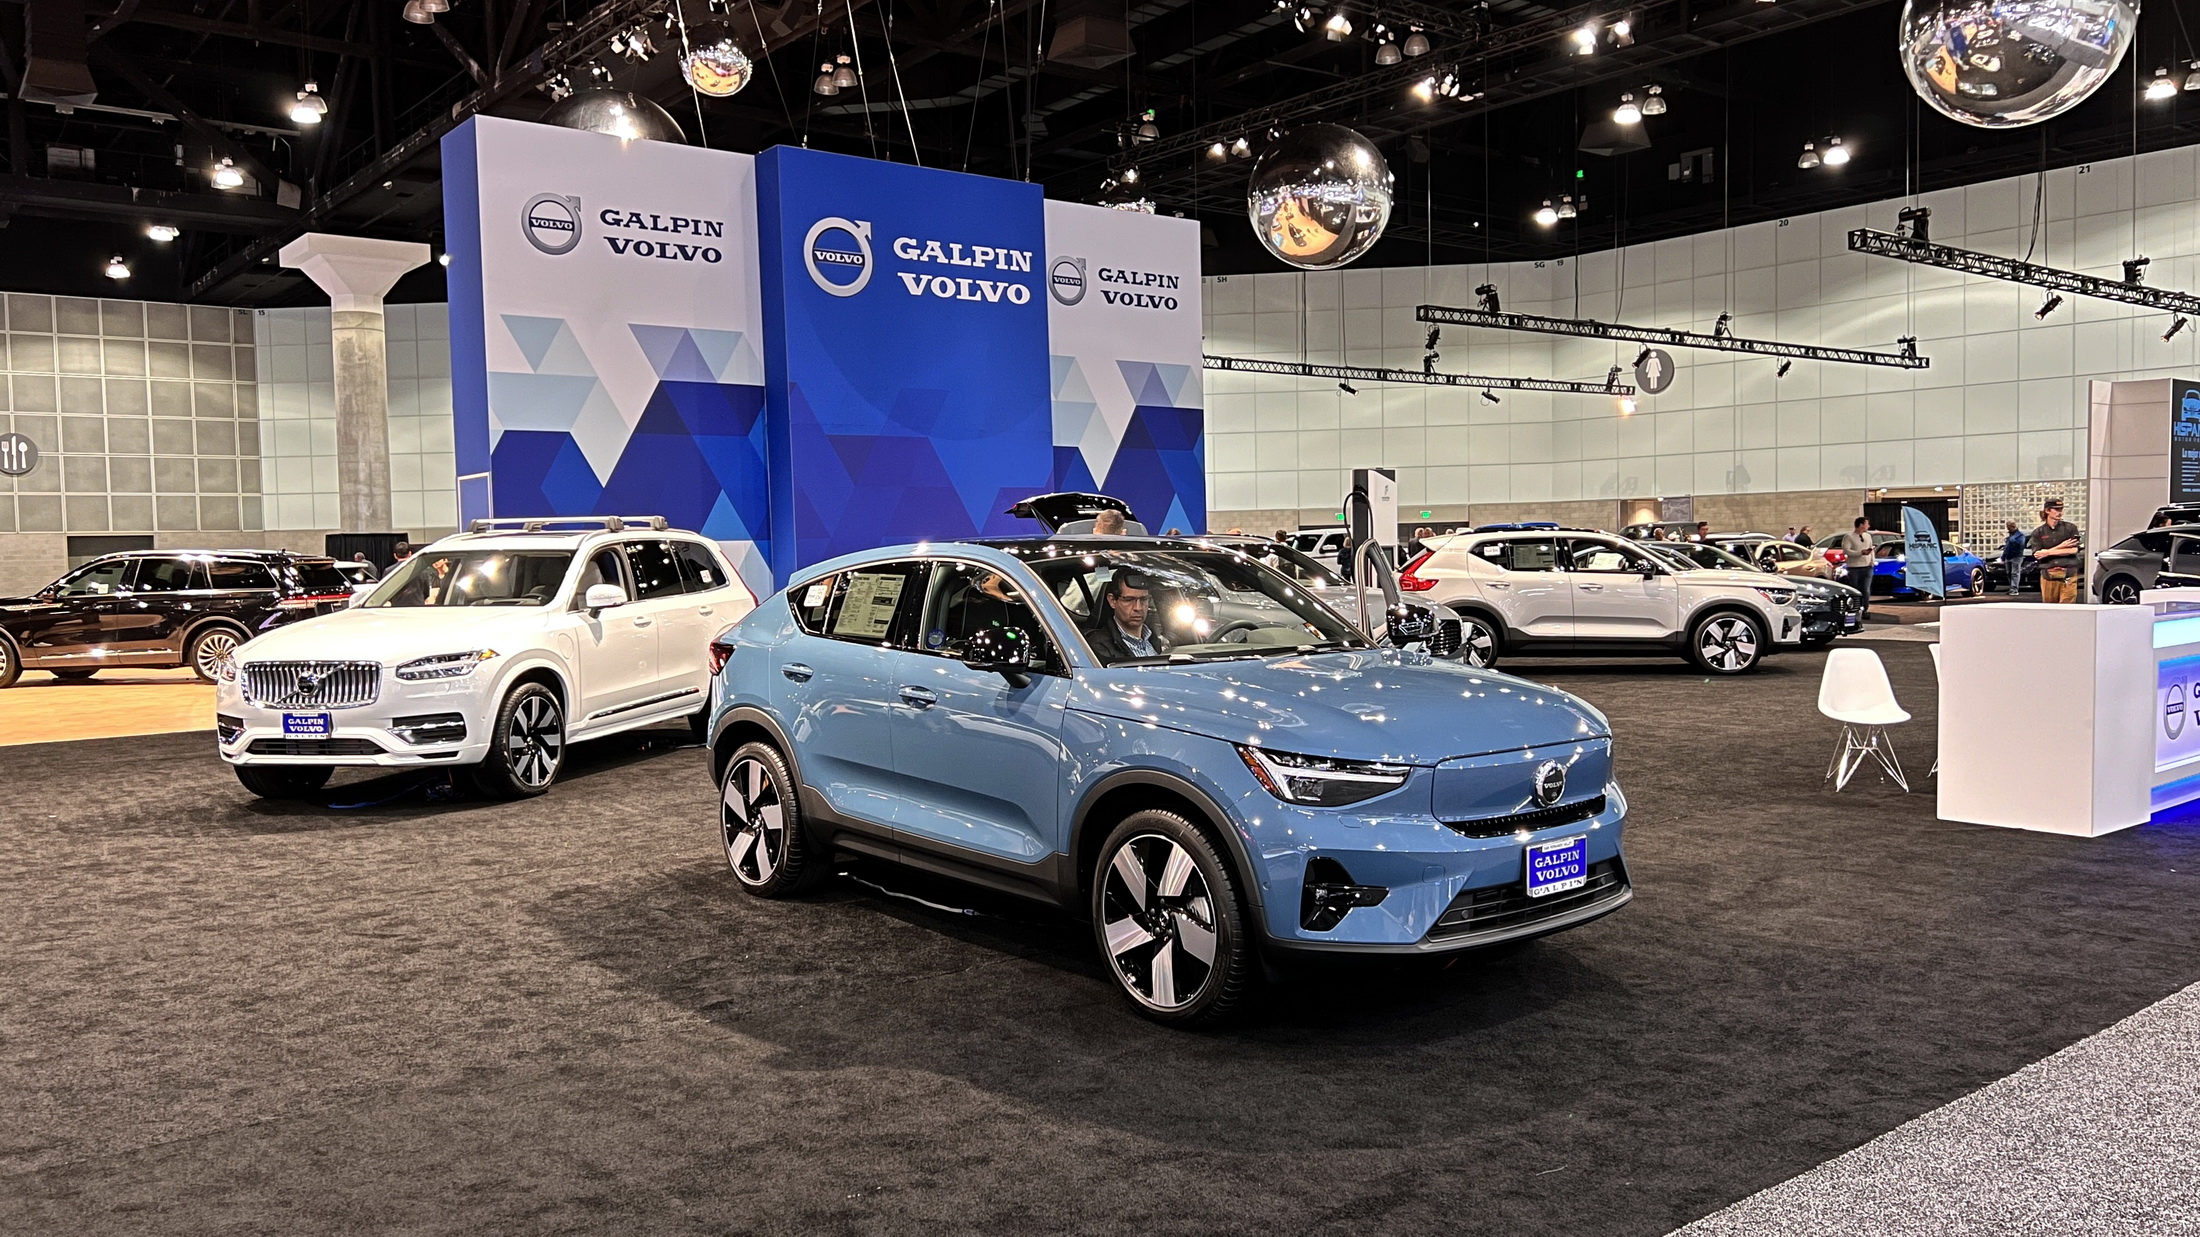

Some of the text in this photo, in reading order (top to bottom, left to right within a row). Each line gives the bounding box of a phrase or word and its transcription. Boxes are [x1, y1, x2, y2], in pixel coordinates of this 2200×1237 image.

[2079, 165, 2090, 174] 21
[531, 218, 573, 231] VOLVO
[600, 208, 724, 238] GALPIN
[1779, 219, 1789, 227] 20
[603, 236, 722, 263] VOLVO
[814, 250, 863, 265] VOLVO
[893, 237, 1032, 272] GALPIN
[1053, 276, 1081, 286] VOLVO
[1098, 268, 1179, 289] GALPIN
[897, 272, 1031, 305] VOLVO
[1101, 289, 1178, 310] VOLVO
[1535, 850, 1580, 869] GALPIN
[1536, 864, 1579, 882] VOLVO
[1533, 879, 1583, 896] GALPIN
